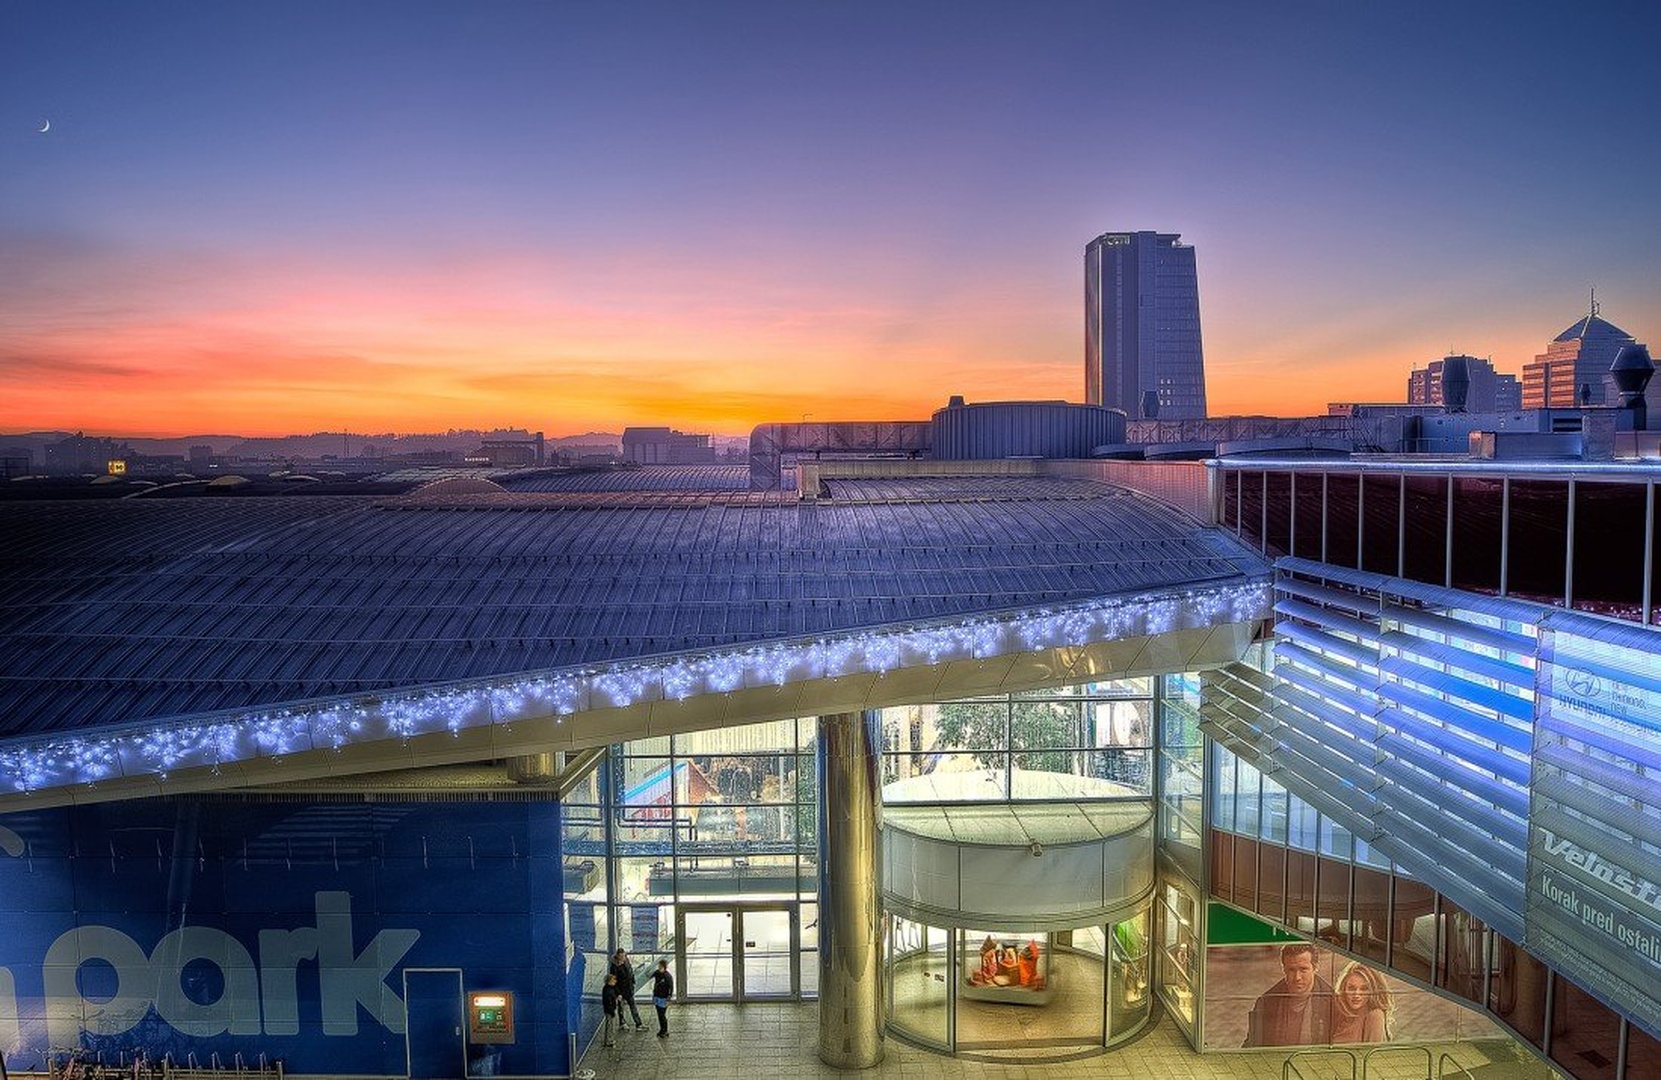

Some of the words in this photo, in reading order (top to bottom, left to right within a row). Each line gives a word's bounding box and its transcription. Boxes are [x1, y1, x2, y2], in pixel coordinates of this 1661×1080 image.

[1542, 875, 1579, 914] Korak
[1582, 903, 1614, 936] pred
[1617, 923, 1661, 963] ostali
